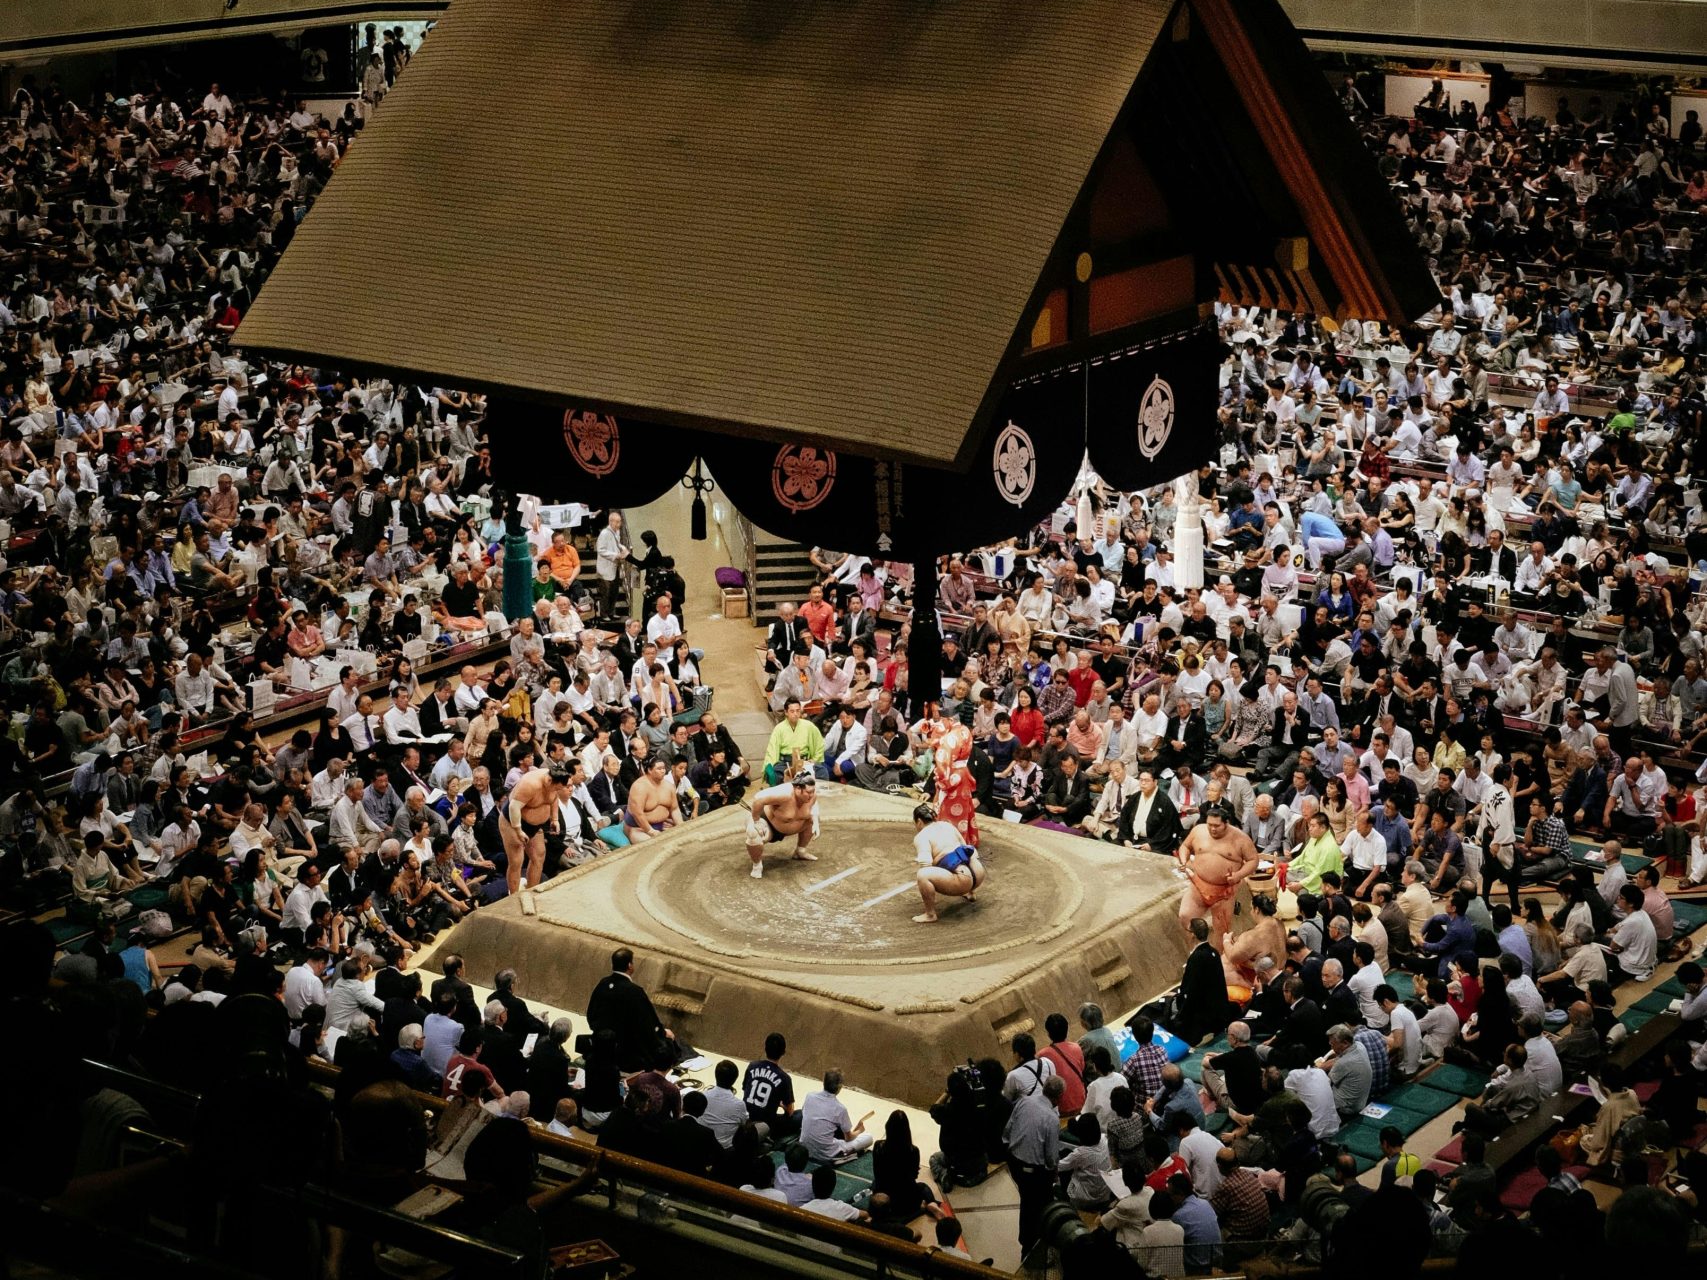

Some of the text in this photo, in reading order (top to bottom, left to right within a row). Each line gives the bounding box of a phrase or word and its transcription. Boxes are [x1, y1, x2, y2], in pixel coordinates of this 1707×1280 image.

[446, 1063, 466, 1091] 4
[749, 1067, 783, 1089] TANAKA
[746, 1079, 773, 1108] 19
